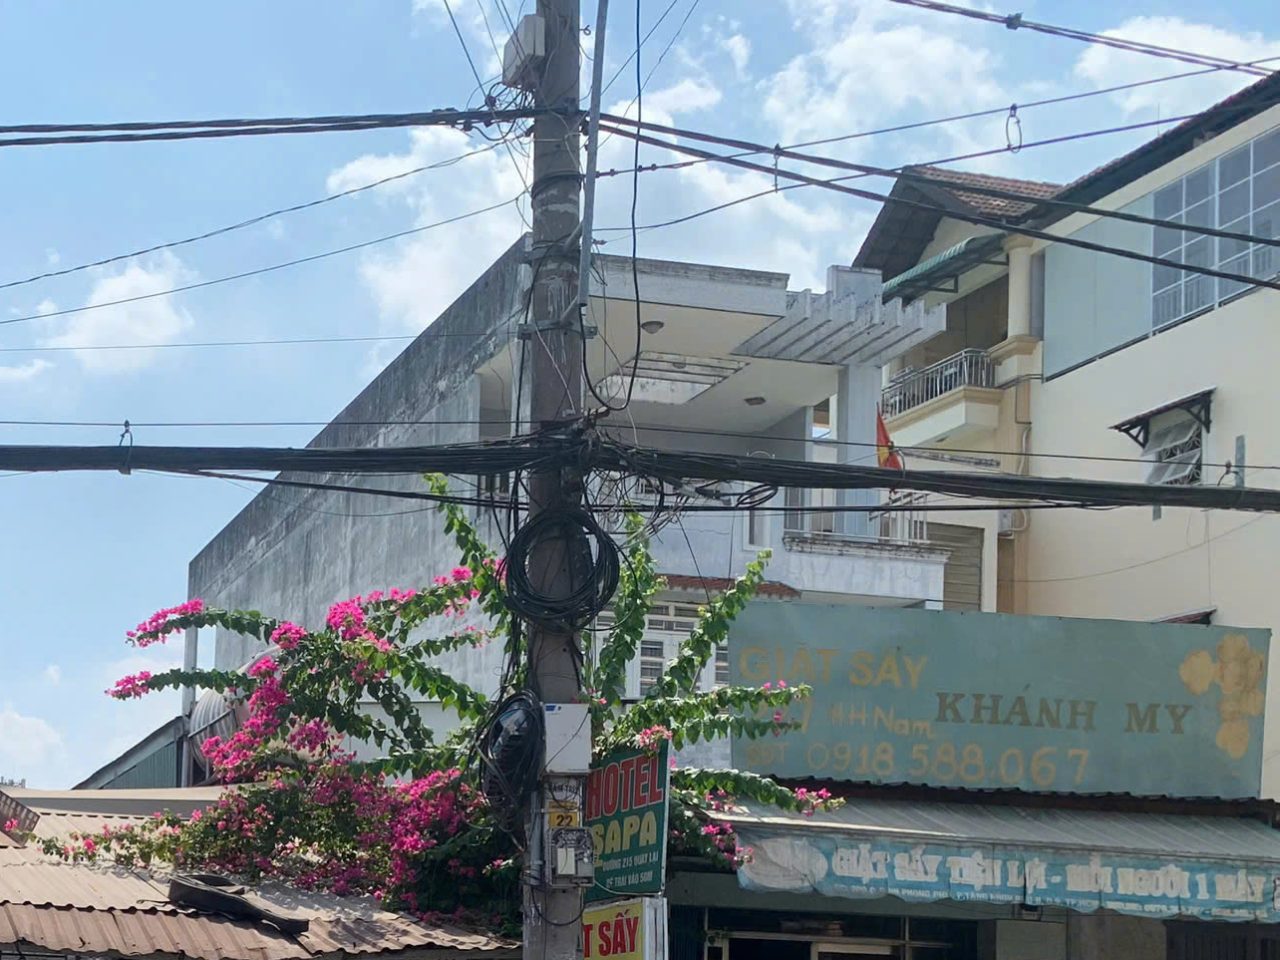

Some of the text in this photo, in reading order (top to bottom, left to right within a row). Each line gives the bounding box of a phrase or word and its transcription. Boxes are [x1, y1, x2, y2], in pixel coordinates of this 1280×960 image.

[933, 683, 1098, 734] KHÁNH
[585, 754, 664, 821] HOTEL
[592, 810, 658, 856] SAPA
[598, 907, 640, 958] SẤY
